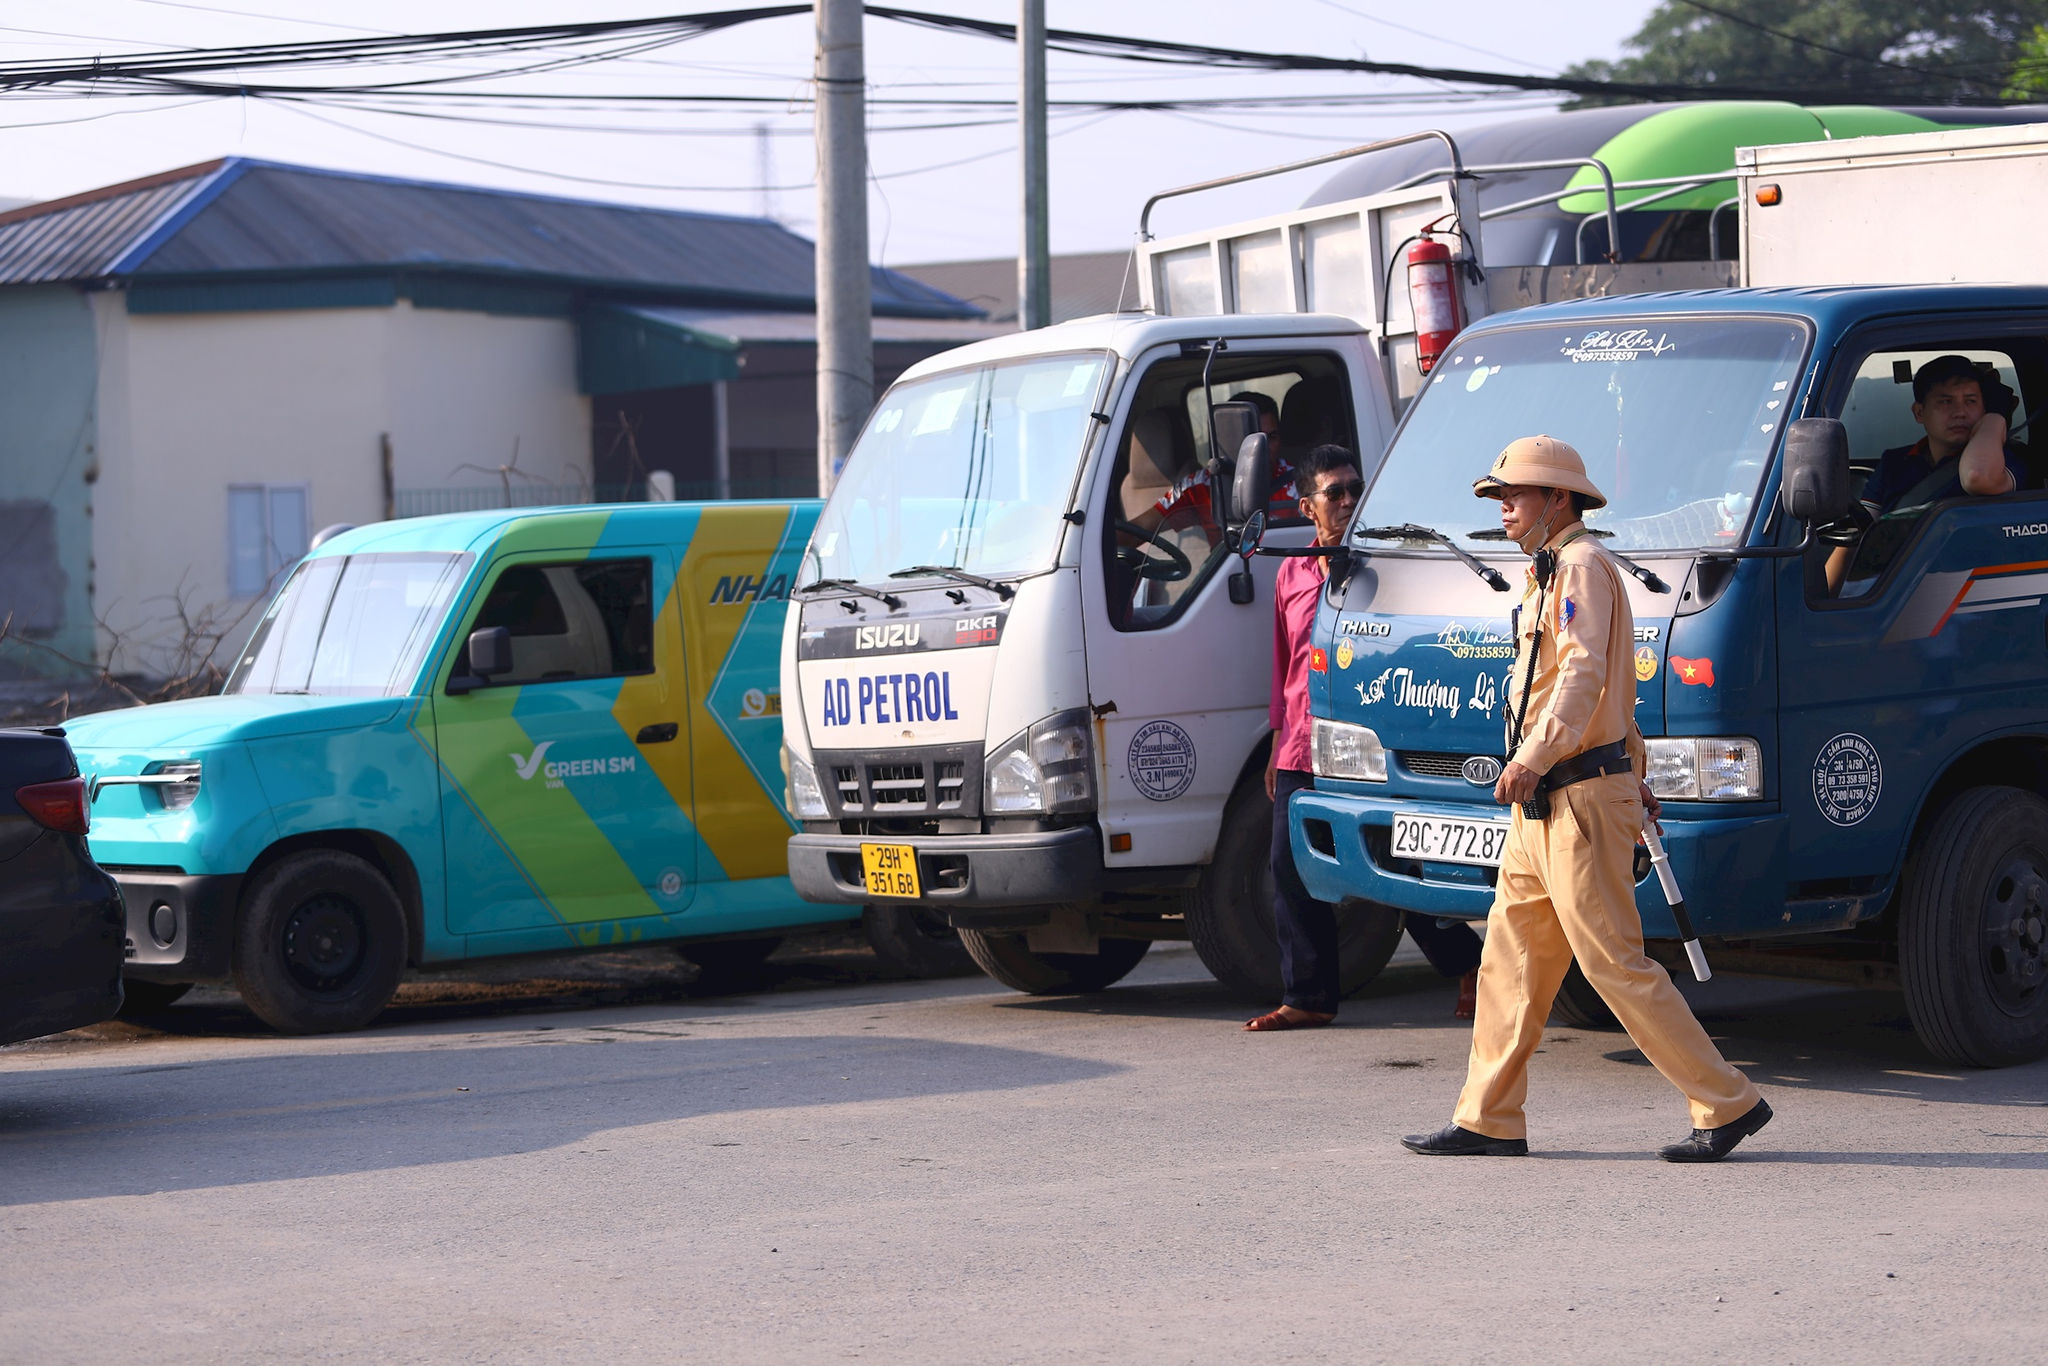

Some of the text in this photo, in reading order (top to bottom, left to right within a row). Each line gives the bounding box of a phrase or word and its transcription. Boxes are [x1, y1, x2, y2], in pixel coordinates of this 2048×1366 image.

[2002, 523, 2048, 537] THACO
[709, 573, 794, 605] NHA
[955, 615, 997, 632] QKR
[1340, 619, 1391, 637] THACO
[855, 622, 920, 650] ISUZU
[955, 628, 997, 645] 230
[1457, 646, 1516, 659] 0973358591
[824, 671, 959, 727] AD PETROL
[1391, 667, 1462, 719] Thượng
[1468, 671, 1497, 720] Lộ
[544, 756, 635, 778] GREEN SM
[1469, 763, 1494, 779] KIA
[1841, 739, 1855, 748] ANH
[1854, 740, 1870, 757] KHOA
[1867, 784, 1877, 803] KIM
[1848, 759, 1863, 770] 4750
[1838, 775, 1846, 785] 73
[1858, 774, 1868, 783] 591
[1396, 820, 1507, 860] 29C-772.87
[876, 847, 902, 869] 29H
[870, 871, 914, 895] 351.68
